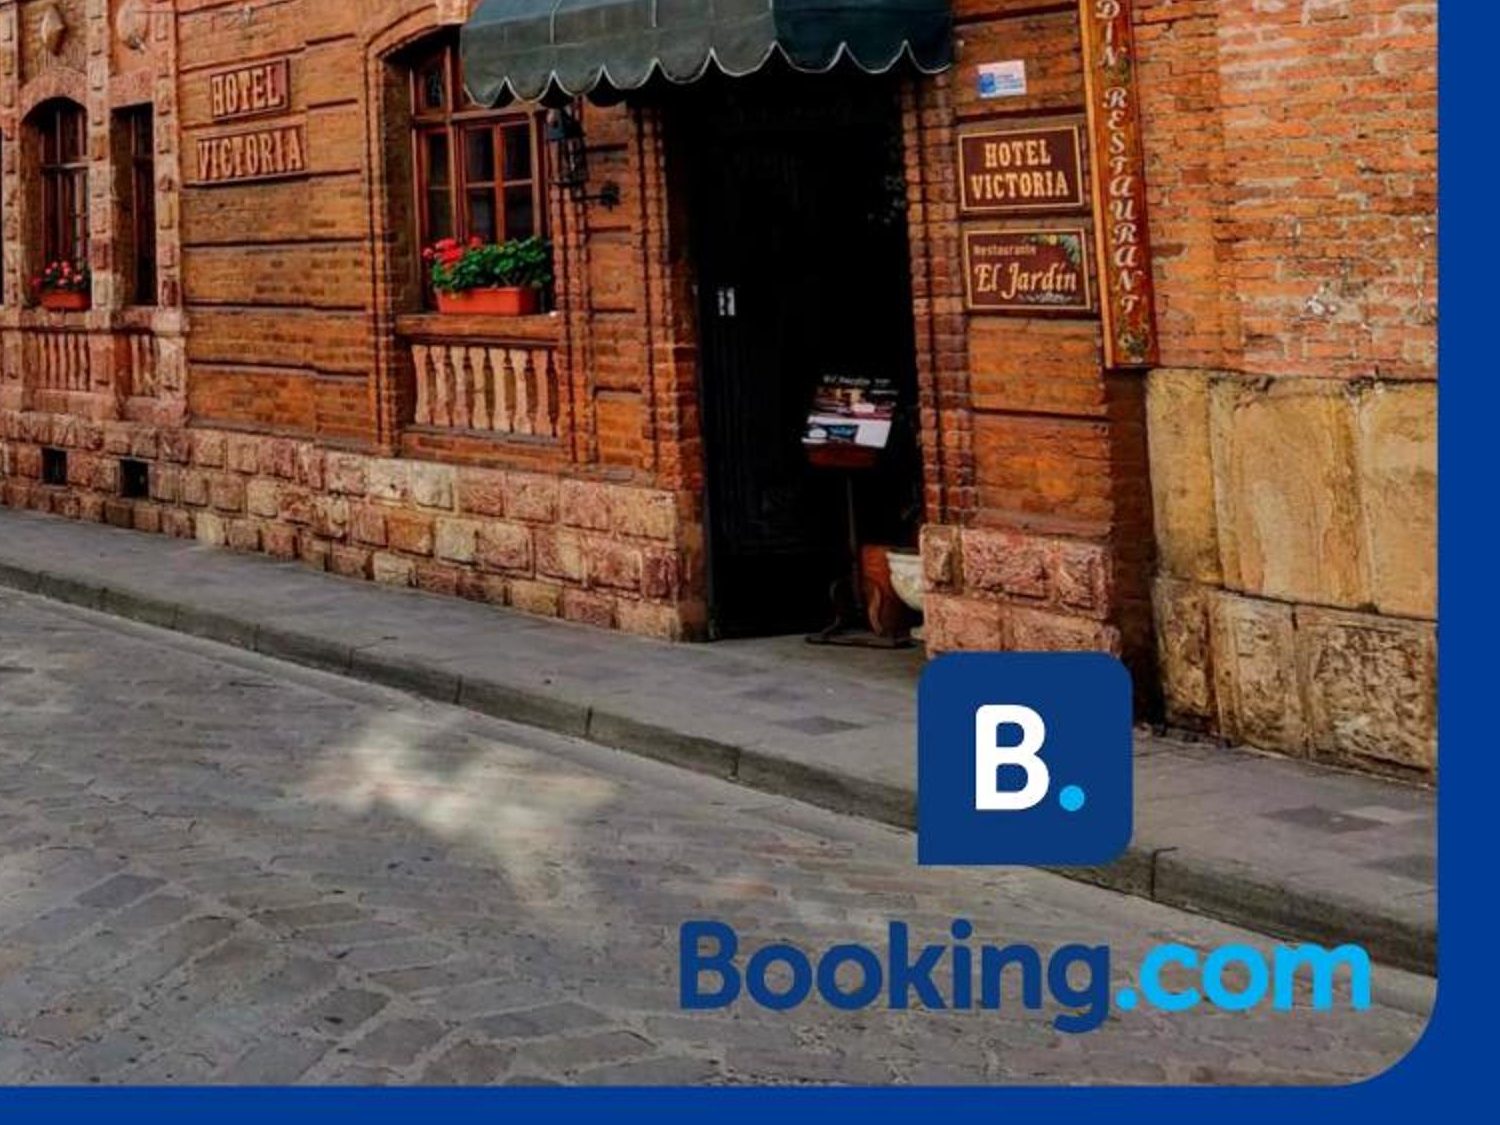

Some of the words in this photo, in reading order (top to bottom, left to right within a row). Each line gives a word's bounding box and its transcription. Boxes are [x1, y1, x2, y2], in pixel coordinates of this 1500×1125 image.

[211, 65, 283, 116] HOTEL
[198, 129, 303, 181] VICTORIA
[984, 139, 1051, 168] HOTEL
[971, 171, 1069, 199] VICTORIA
[1102, 86, 1143, 314] RESTAURANT
[974, 263, 1001, 292] El
[1002, 262, 1077, 300] Jardín
